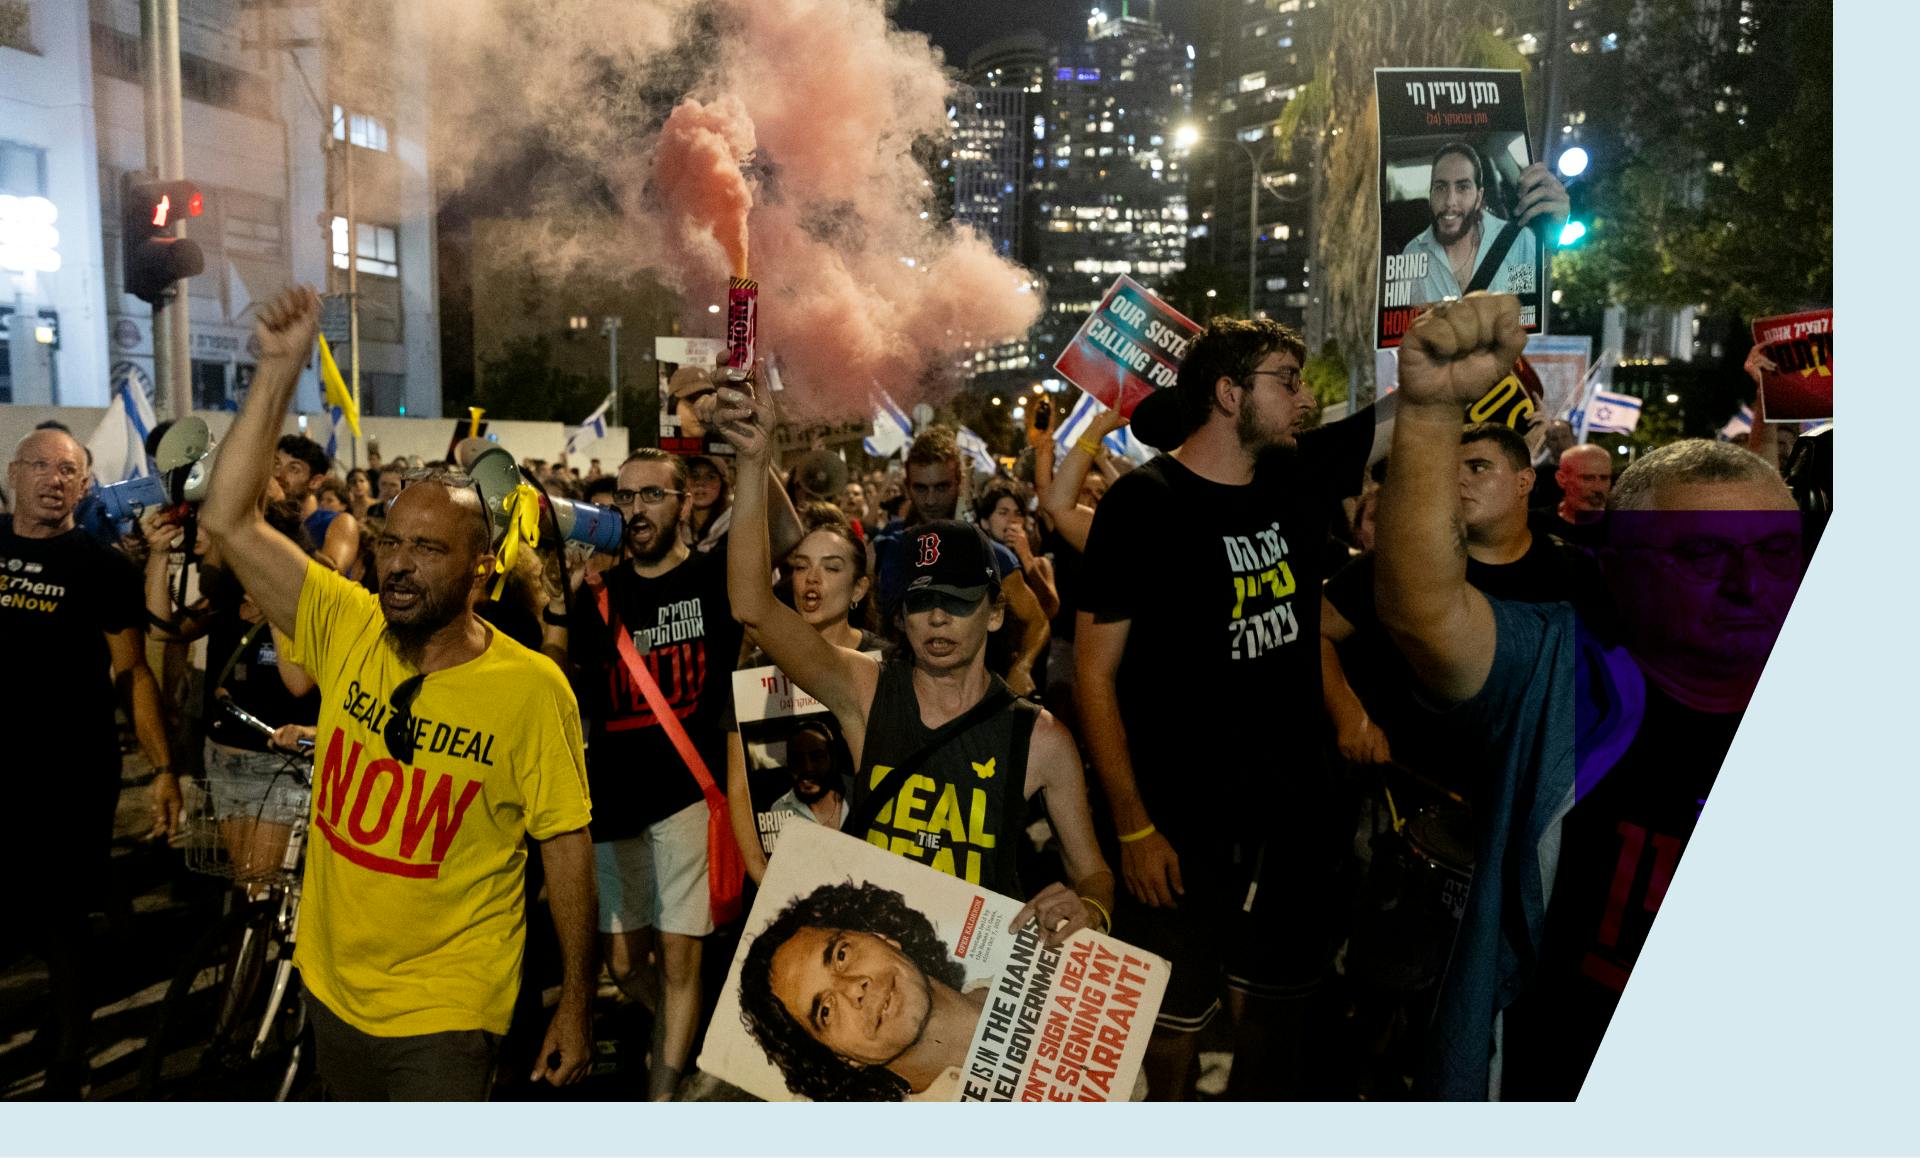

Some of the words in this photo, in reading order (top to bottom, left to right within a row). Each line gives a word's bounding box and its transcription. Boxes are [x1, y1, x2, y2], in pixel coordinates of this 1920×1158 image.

[1405, 82, 1425, 105] חי
[1428, 81, 1466, 110] עדיין
[1468, 81, 1500, 109] מתן
[1426, 112, 1441, 126] (24)
[1385, 253, 1428, 281] BRING
[1384, 281, 1411, 307] HIM
[1109, 295, 1147, 329] OUR
[1086, 318, 1151, 372] CALLING
[915, 532, 941, 567] B
[1222, 535, 1262, 572] הם
[0, 593, 58, 613] eNow
[658, 597, 703, 626] מחזירים
[671, 616, 705, 643] אותם
[343, 681, 386, 735] SEAL
[429, 722, 495, 767] DEAL
[317, 726, 483, 862] NOW
[918, 831, 941, 849] THE
[958, 936, 970, 954] OFER
[999, 914, 1040, 999] HANDS
[1060, 940, 1095, 993] DEAL
[1055, 995, 1076, 1014] A
[1055, 985, 1107, 1087] SIGNING
[1088, 943, 1120, 987] MY
[982, 996, 1016, 1044] THE
[1078, 954, 1152, 1102] WARRANT!
[1037, 1011, 1070, 1061] SIGN
[975, 1046, 1000, 1066] IN
[970, 1062, 994, 1082] IS
